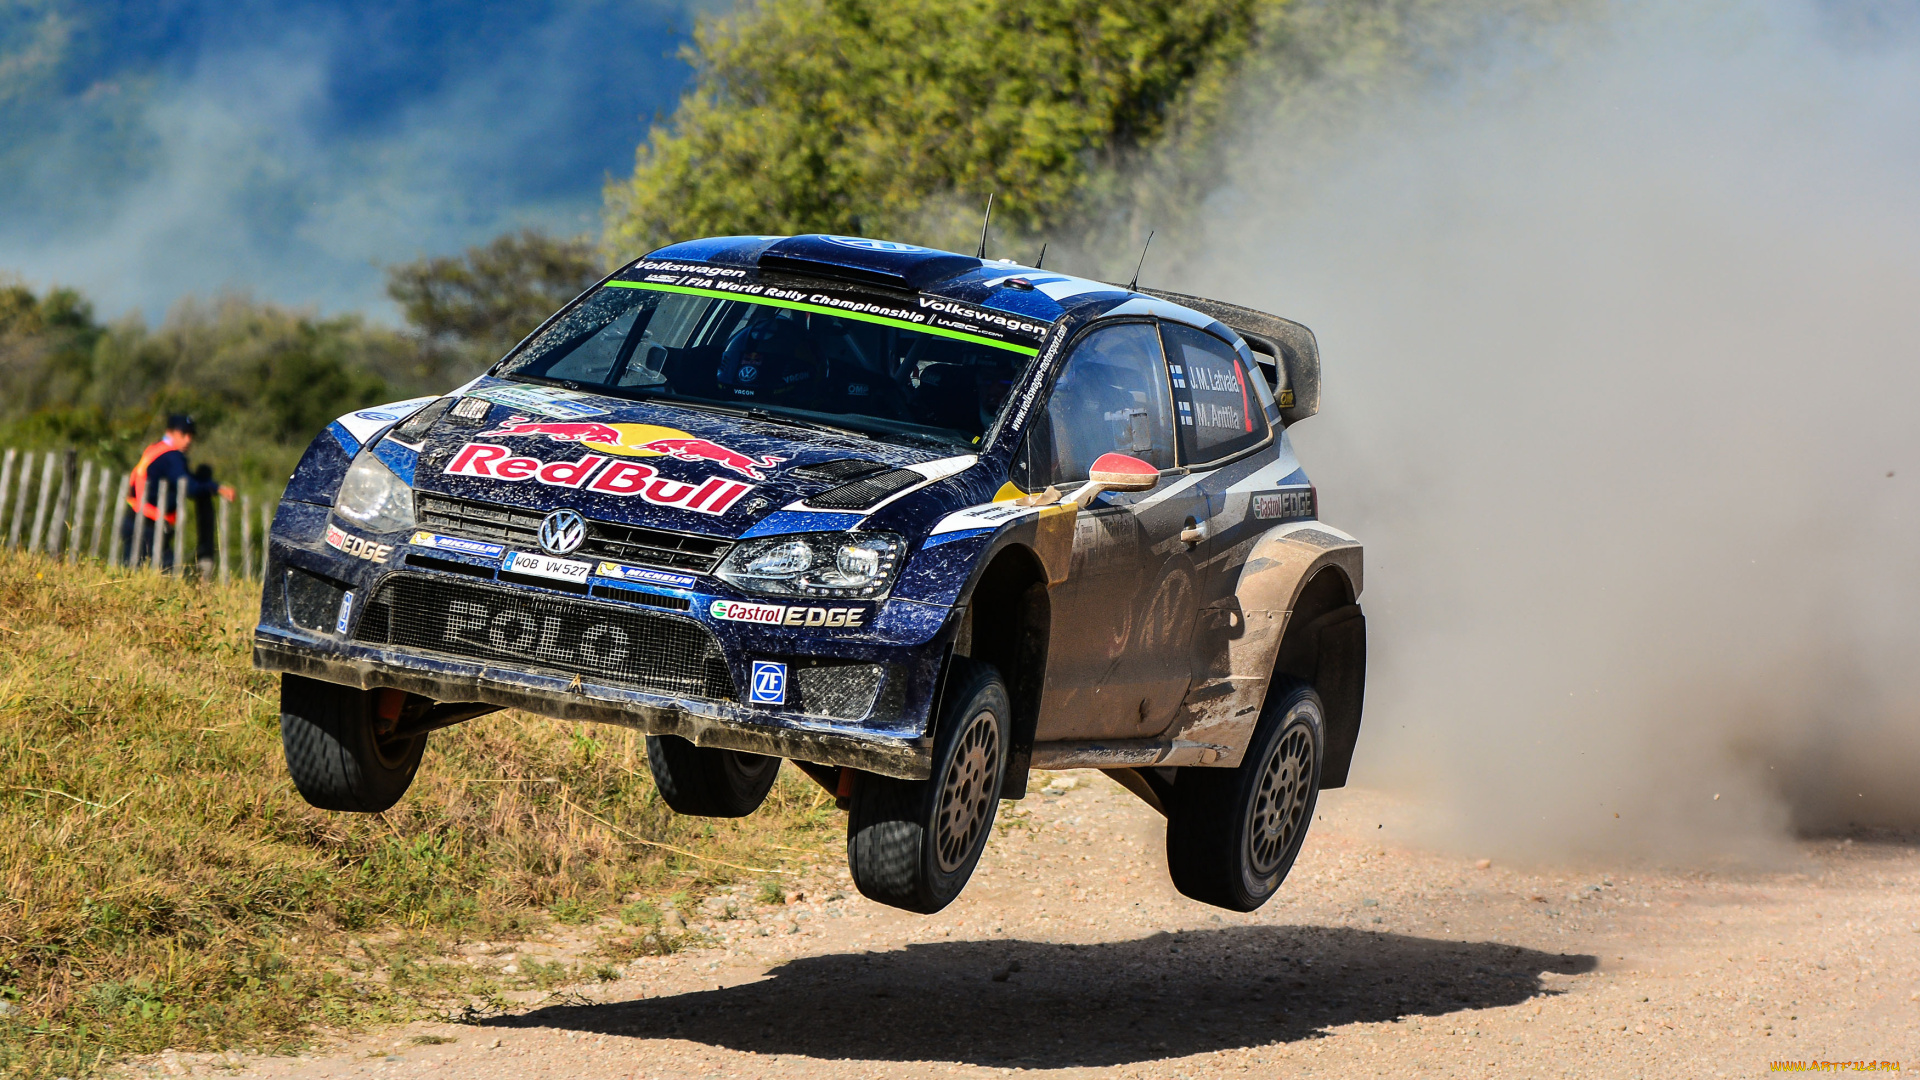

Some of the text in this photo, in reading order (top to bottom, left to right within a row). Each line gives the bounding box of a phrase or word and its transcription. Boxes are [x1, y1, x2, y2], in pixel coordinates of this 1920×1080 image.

[634, 261, 746, 278] Volkswagen
[685, 277, 714, 287] FIA
[716, 280, 761, 294] World
[764, 288, 807, 302] Rally
[809, 294, 926, 323] Championship
[919, 297, 1048, 336] Volkswagen
[1011, 324, 1068, 432] www.volkswagen-motorsport.com
[1207, 367, 1240, 393] Latvala
[1212, 404, 1241, 430] Anttila
[447, 443, 750, 514] Red Bull
[1260, 492, 1312, 518] Castrol EDGE
[341, 533, 395, 563] EDGE
[437, 537, 502, 554] MICHELIN
[514, 556, 588, 577] WOB VW 527
[625, 568, 694, 585] MICHELIN
[727, 603, 866, 628] Castrol EDGE
[442, 599, 630, 670] POLO
